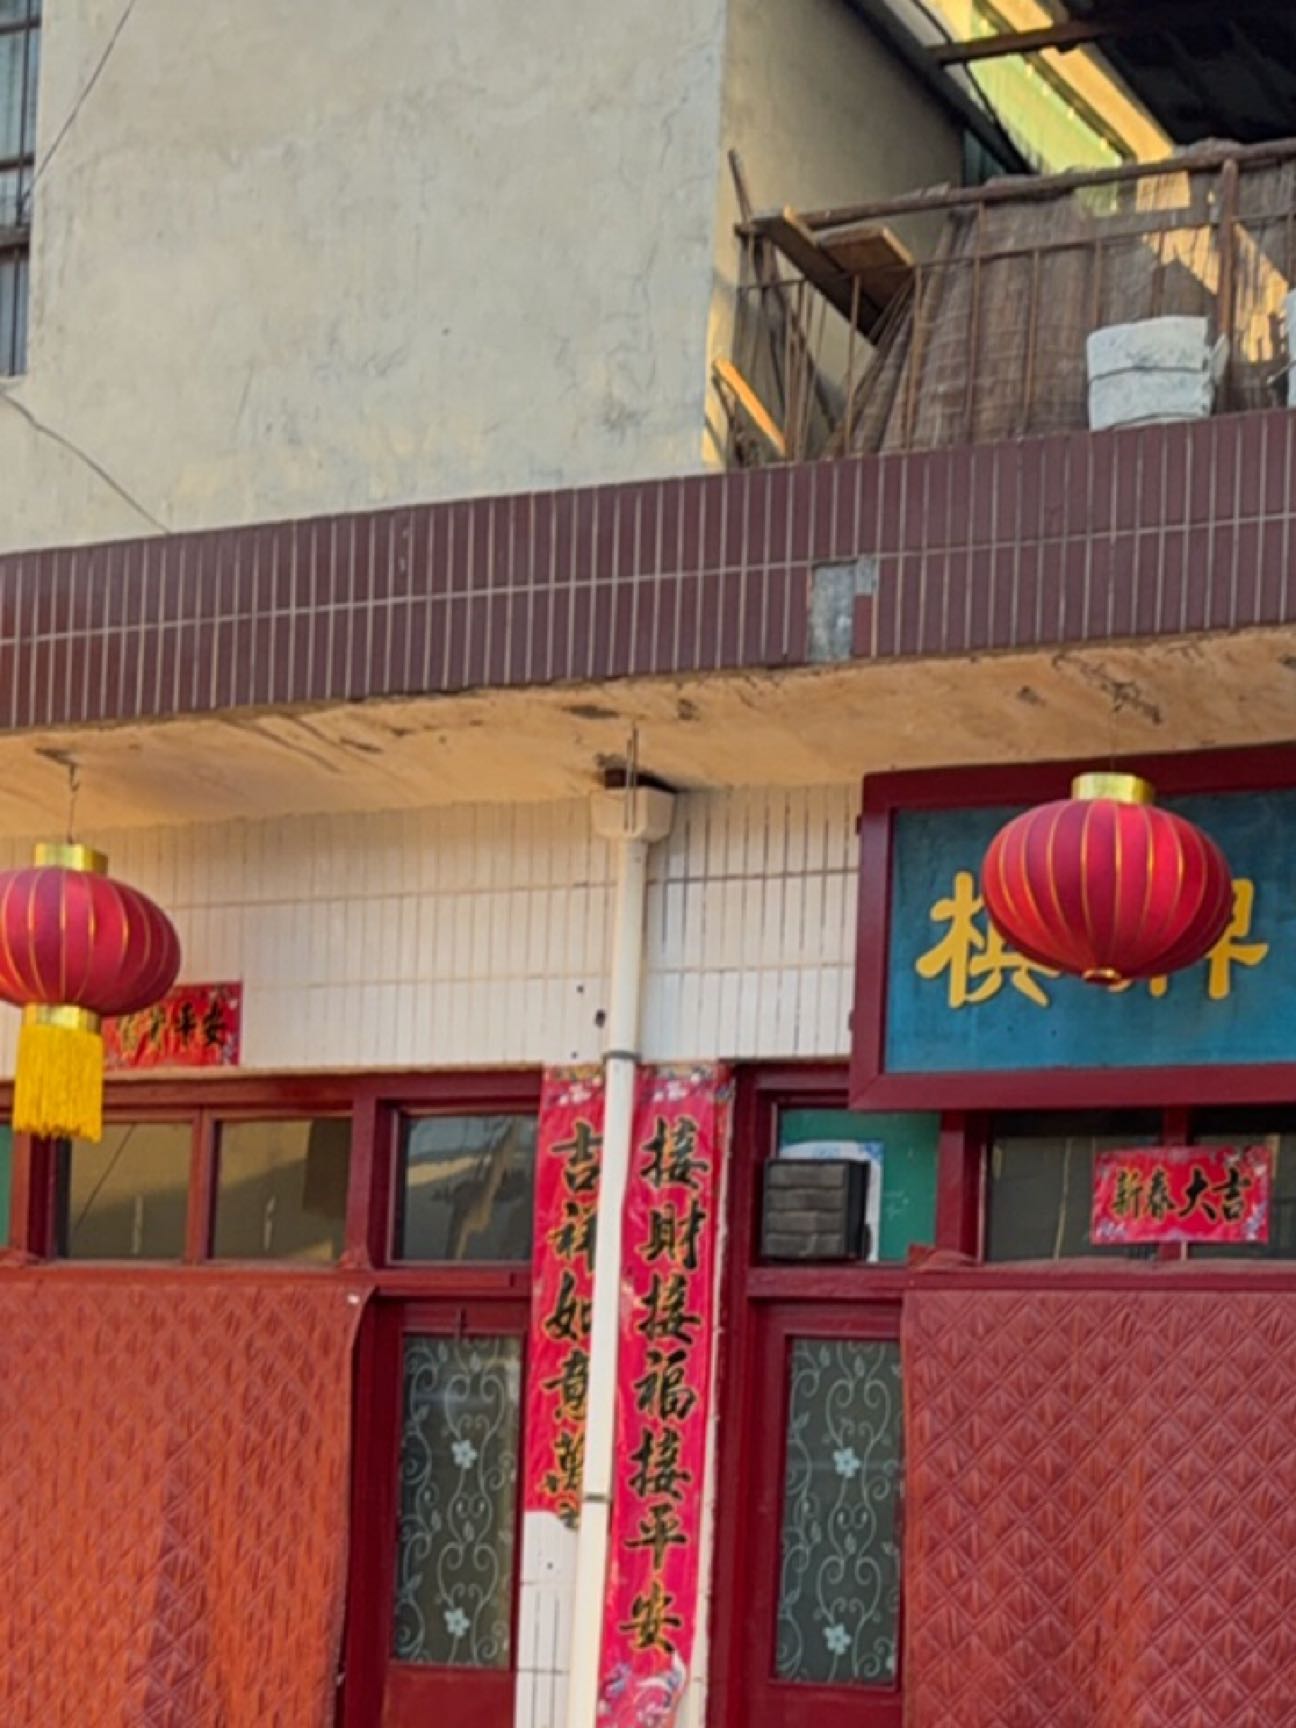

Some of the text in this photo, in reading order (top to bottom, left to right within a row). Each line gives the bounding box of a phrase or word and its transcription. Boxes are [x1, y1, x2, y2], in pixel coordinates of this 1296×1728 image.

[621, 1116, 708, 1655] 接財接福接平安
